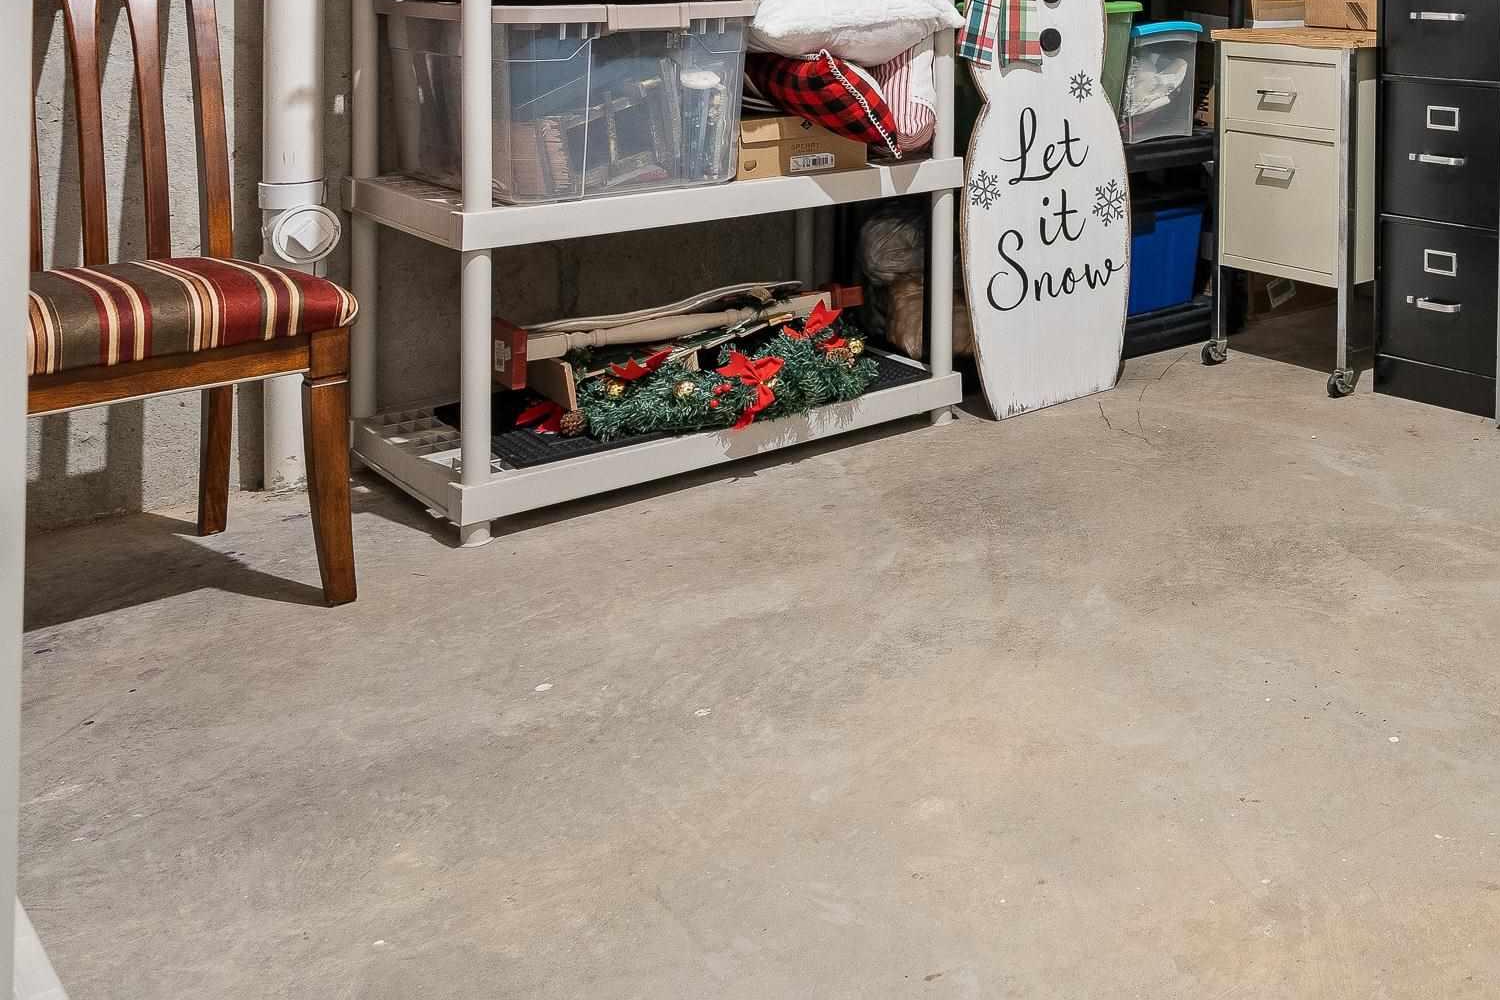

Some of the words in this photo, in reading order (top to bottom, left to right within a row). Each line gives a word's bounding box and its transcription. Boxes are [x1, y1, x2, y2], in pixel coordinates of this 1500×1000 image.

[1000, 107, 1089, 185] Let
[1039, 188, 1086, 246] it
[986, 229, 1125, 312] Snow
